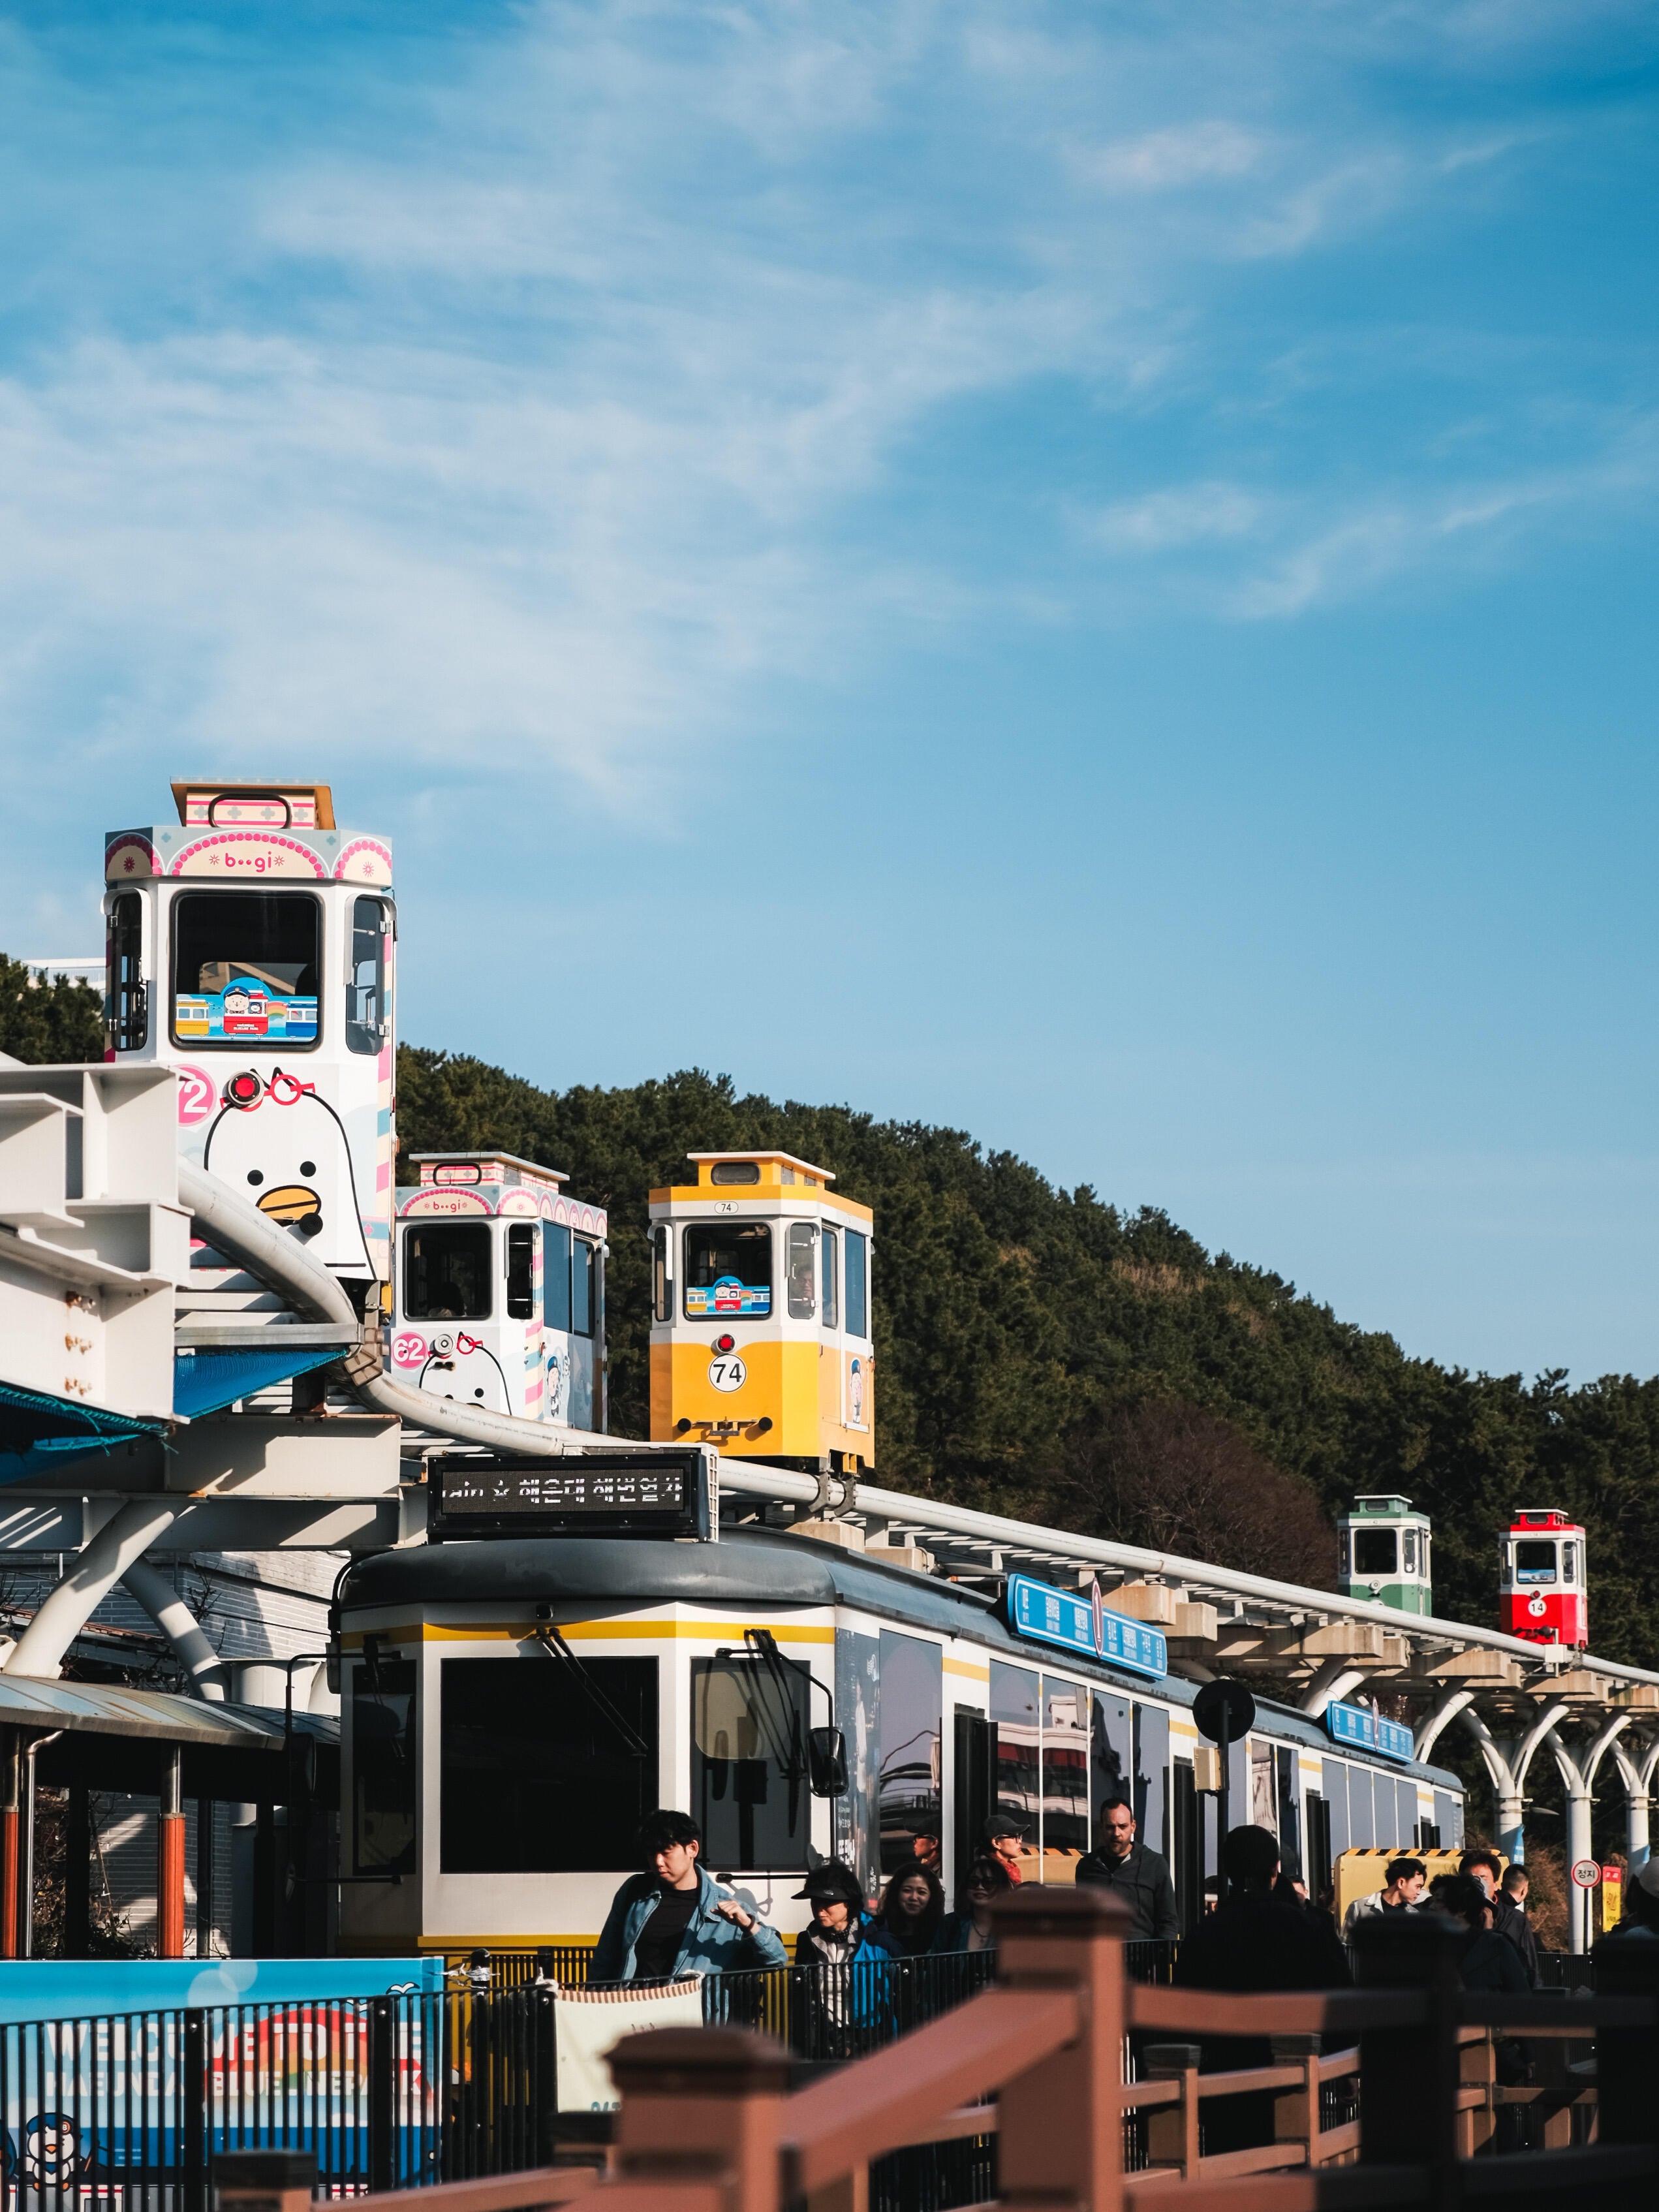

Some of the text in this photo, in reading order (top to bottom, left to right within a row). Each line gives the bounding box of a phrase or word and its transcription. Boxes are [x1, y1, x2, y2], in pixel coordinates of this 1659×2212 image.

[178, 1079, 208, 1114] 2
[721, 1203, 732, 1212] 74
[393, 1338, 424, 1362] 62
[713, 1363, 742, 1383] 74
[1531, 1603, 1543, 1612] 14
[1578, 1869, 1595, 1879] 정지
[341, 2021, 422, 2061] TE
[46, 2071, 185, 2097] HAEUNDA
[211, 2071, 342, 2097] BLUENE
